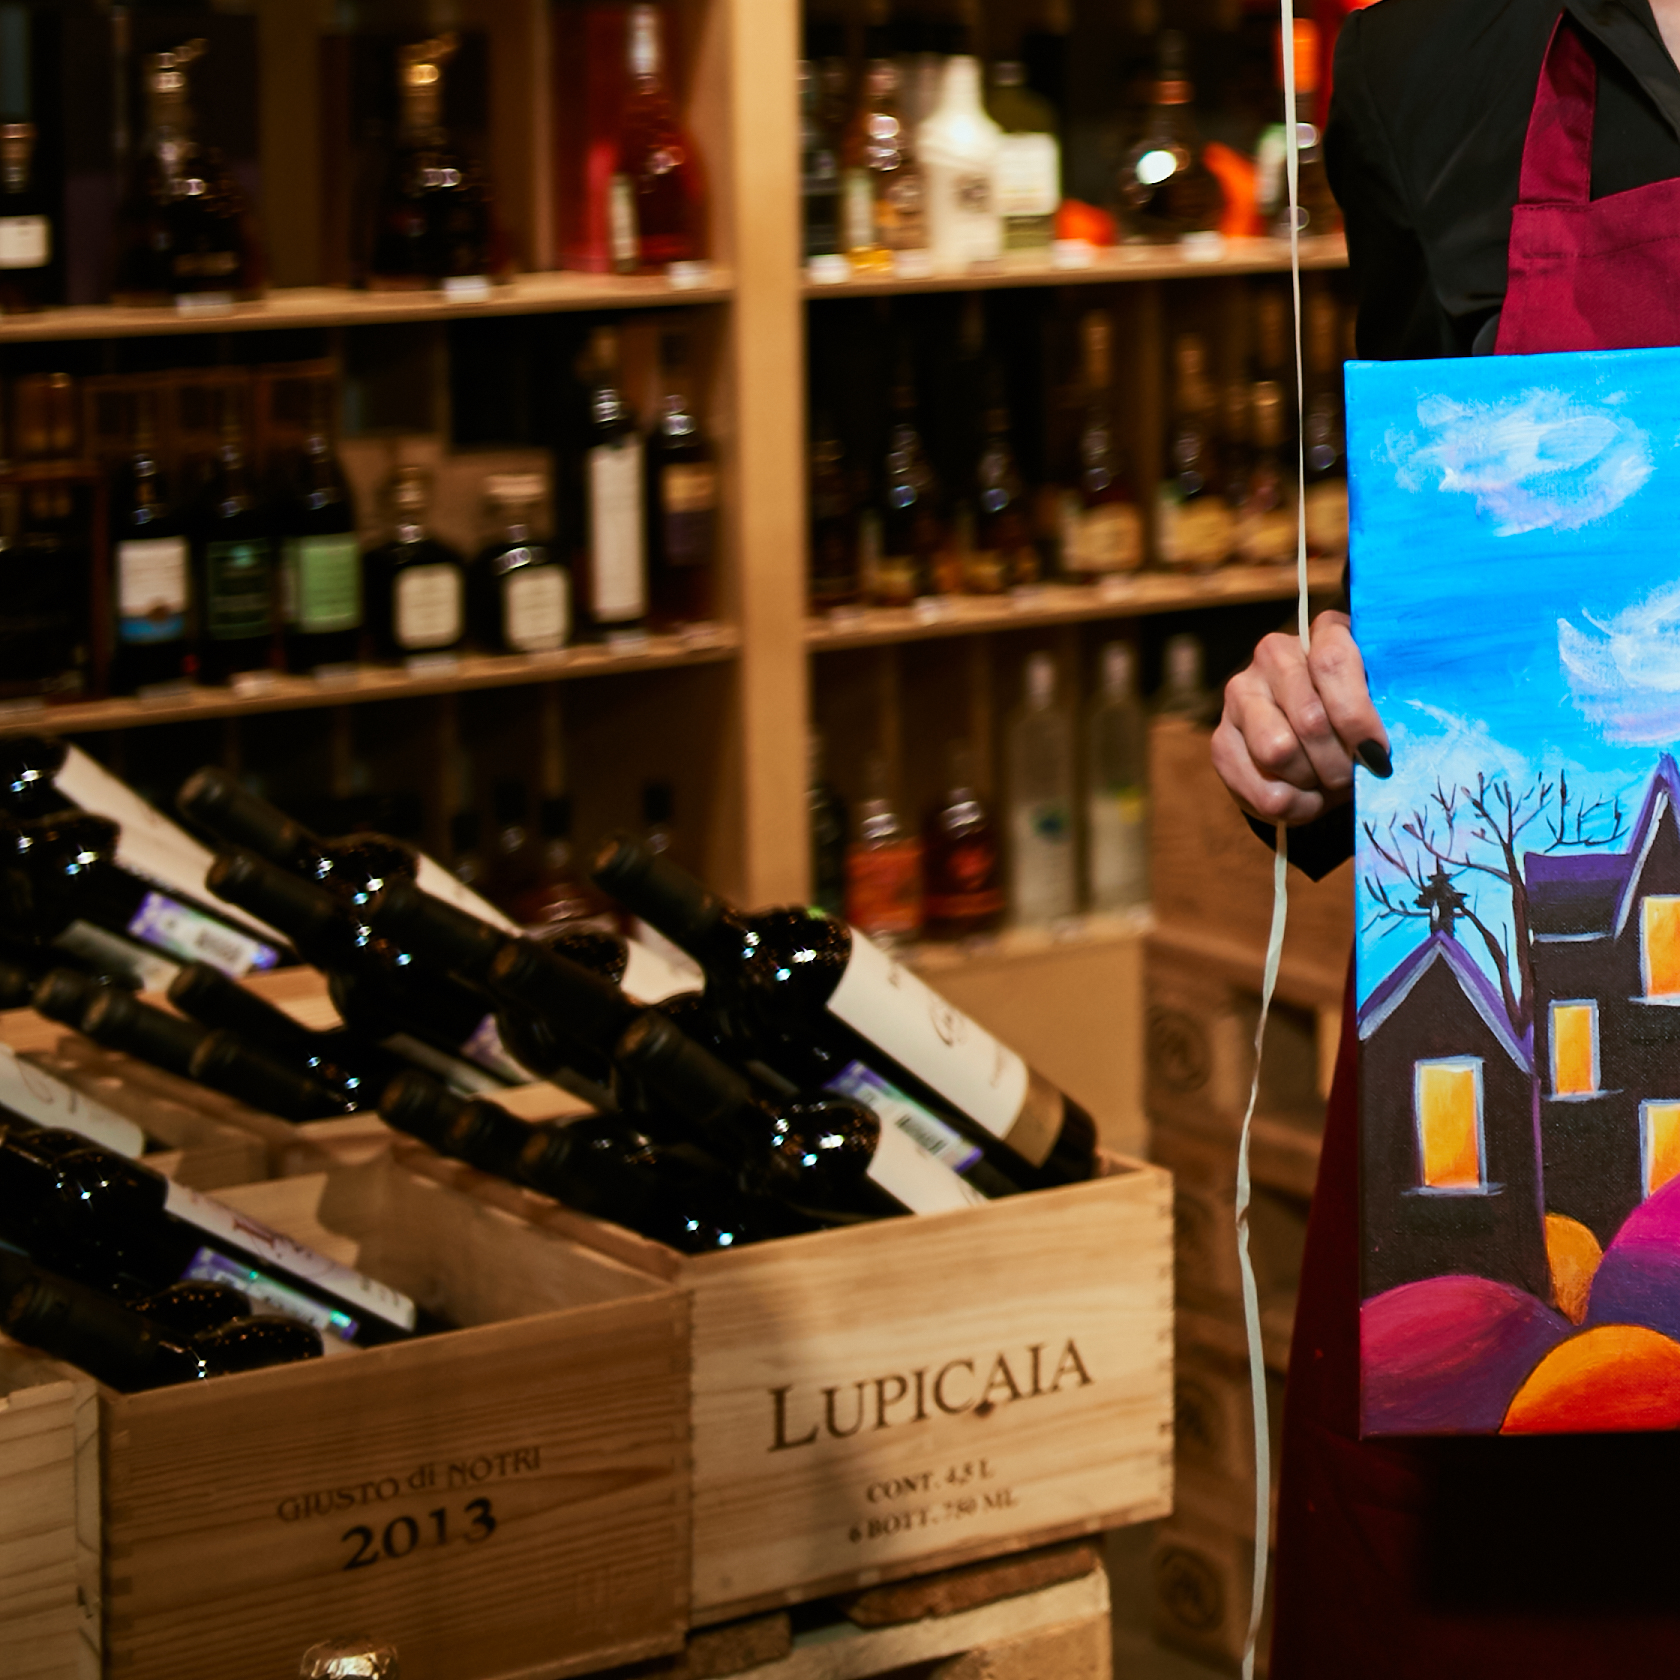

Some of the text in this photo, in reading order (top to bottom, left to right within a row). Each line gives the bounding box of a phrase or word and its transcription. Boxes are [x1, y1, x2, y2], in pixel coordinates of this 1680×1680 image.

[767, 1337, 1094, 1453] LUPICAIA
[277, 1445, 542, 1523] GIUSTO di NOTRI
[866, 1472, 942, 1504] CONT.
[340, 1496, 498, 1572] 2013
